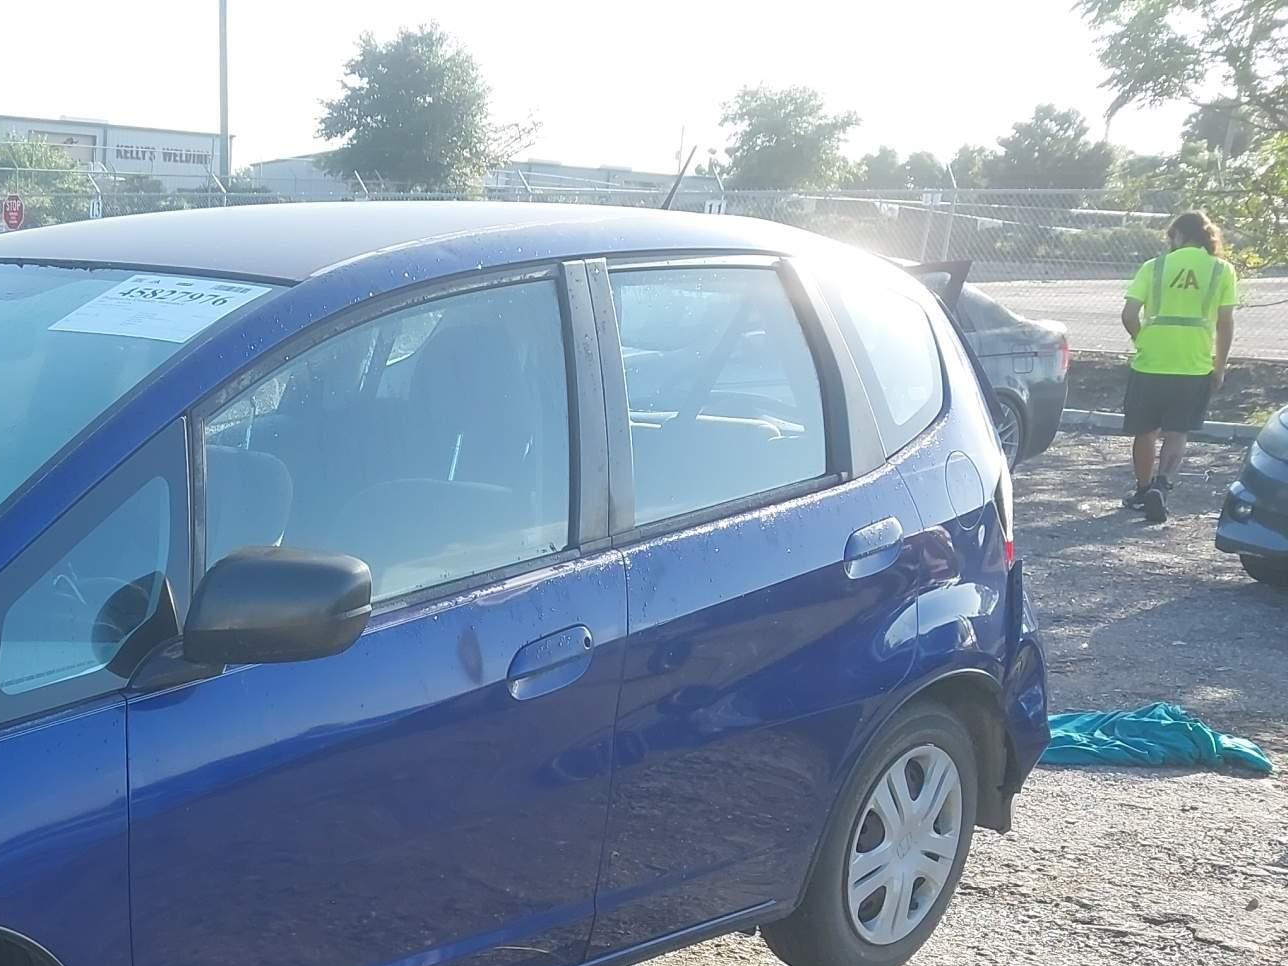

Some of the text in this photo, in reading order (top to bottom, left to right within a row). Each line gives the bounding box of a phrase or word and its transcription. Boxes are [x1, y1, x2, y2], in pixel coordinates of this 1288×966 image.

[116, 144, 156, 161] KELLY'S
[6, 200, 21, 212] STOP
[119, 287, 228, 306] 45827976
